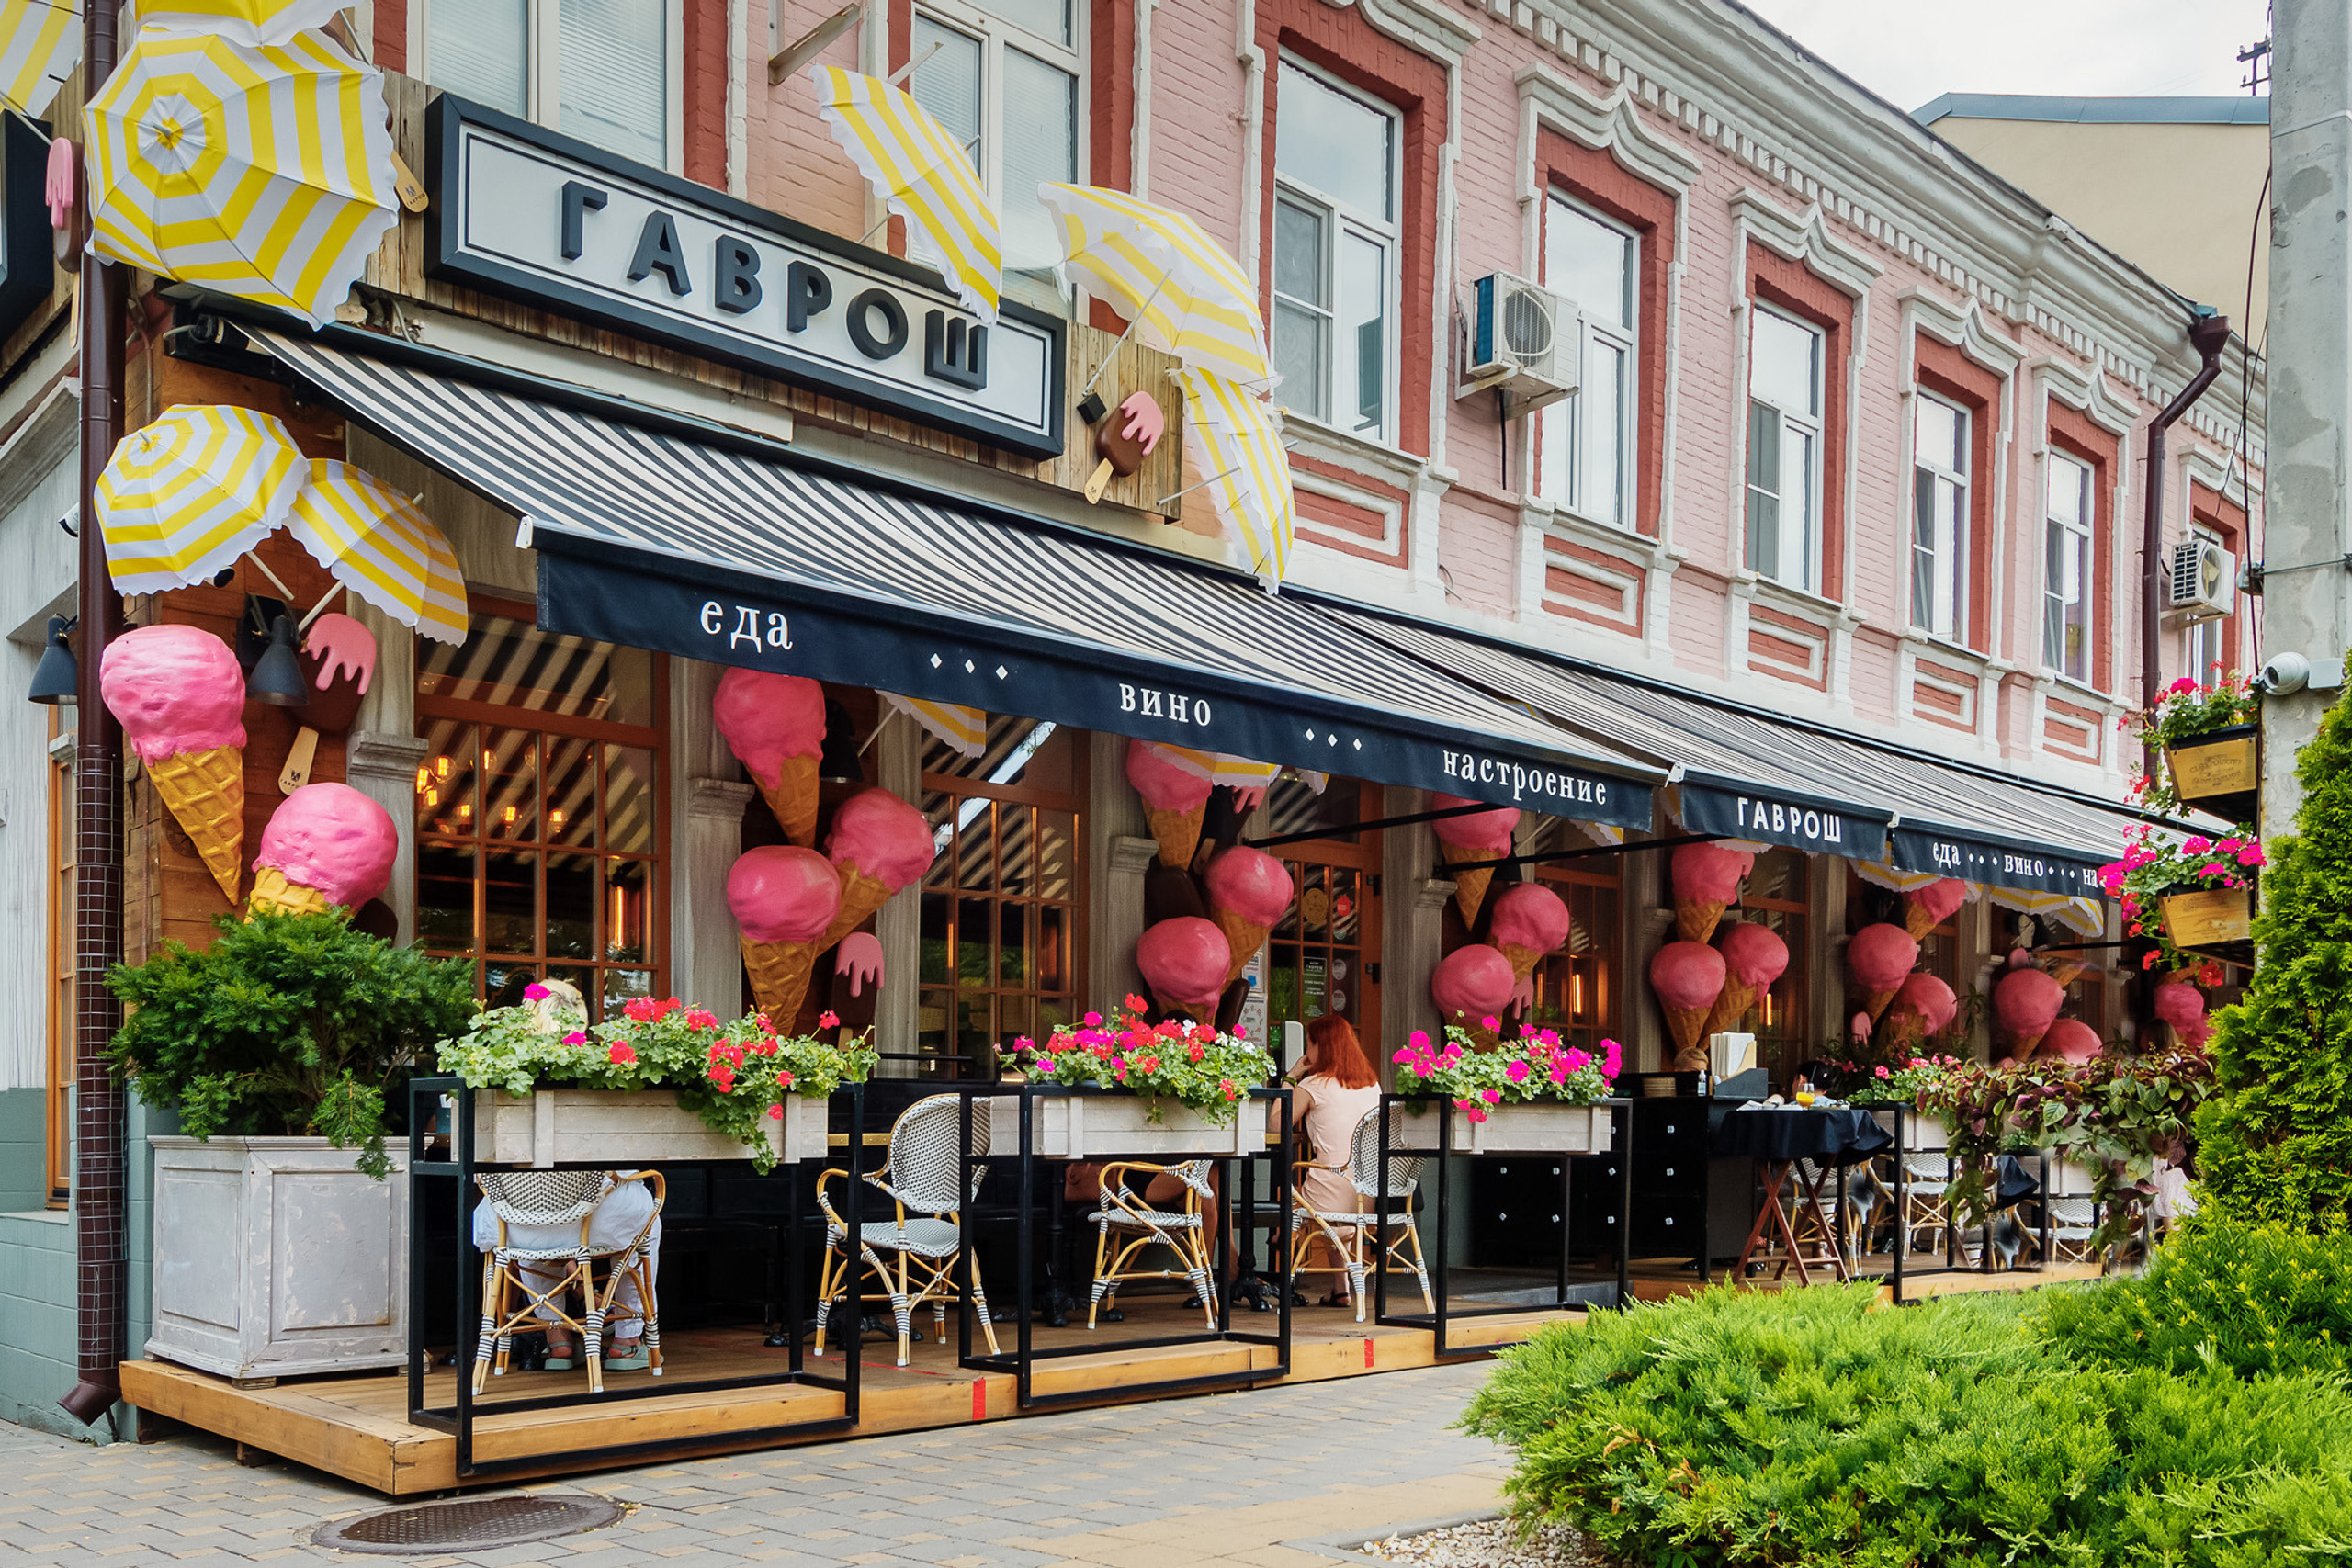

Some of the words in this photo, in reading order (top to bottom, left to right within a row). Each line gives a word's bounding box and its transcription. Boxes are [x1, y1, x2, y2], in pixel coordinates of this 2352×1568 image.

[560, 179, 989, 391] ГАВРОШ
[699, 600, 793, 652] еда
[1119, 682, 1212, 727] вино
[1442, 749, 1608, 805] настроение
[1737, 797, 1842, 843] ГАВРОШ
[1932, 841, 1962, 869] еда
[2004, 854, 2044, 877] вино
